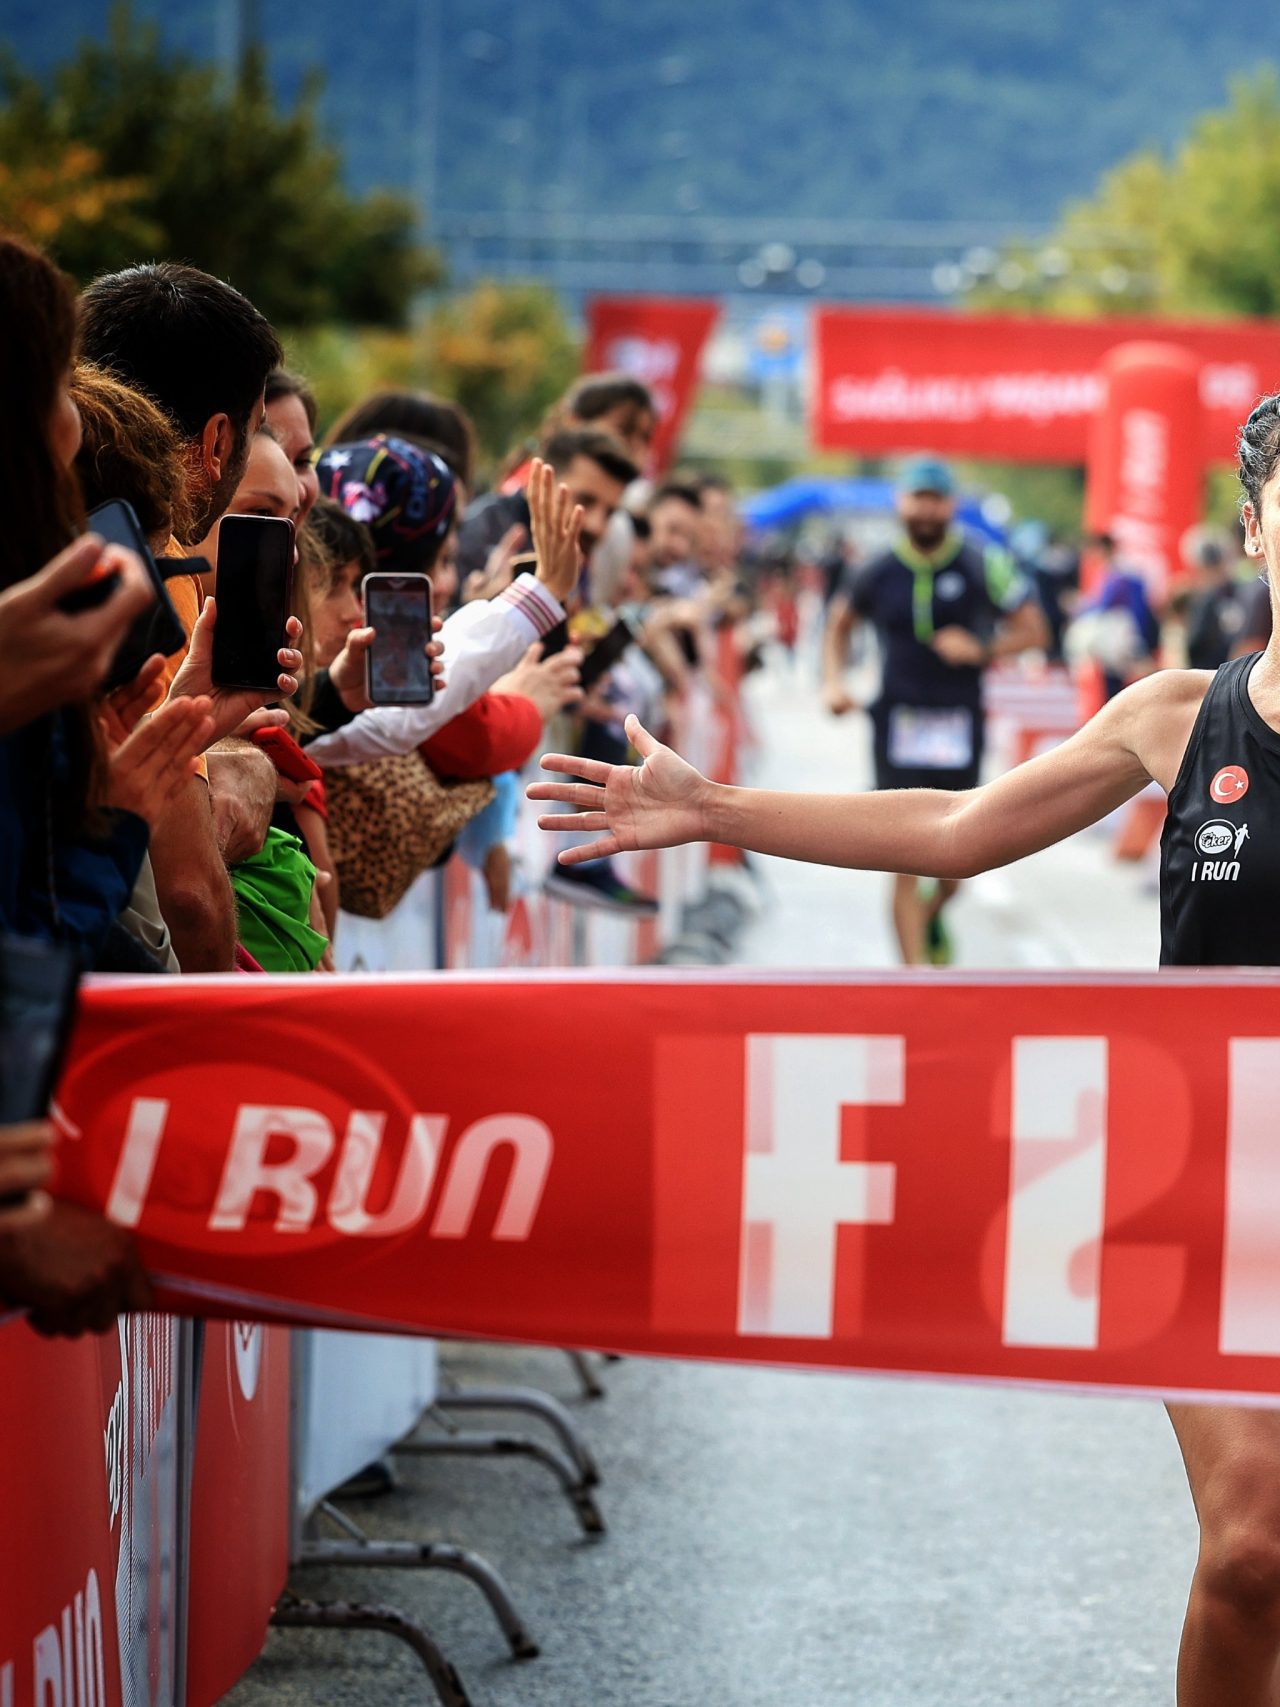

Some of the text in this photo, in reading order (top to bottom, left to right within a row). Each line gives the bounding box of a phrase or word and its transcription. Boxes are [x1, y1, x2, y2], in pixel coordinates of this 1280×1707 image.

[1191, 861, 1241, 881] I RUN
[106, 1097, 554, 1241] I RUN
